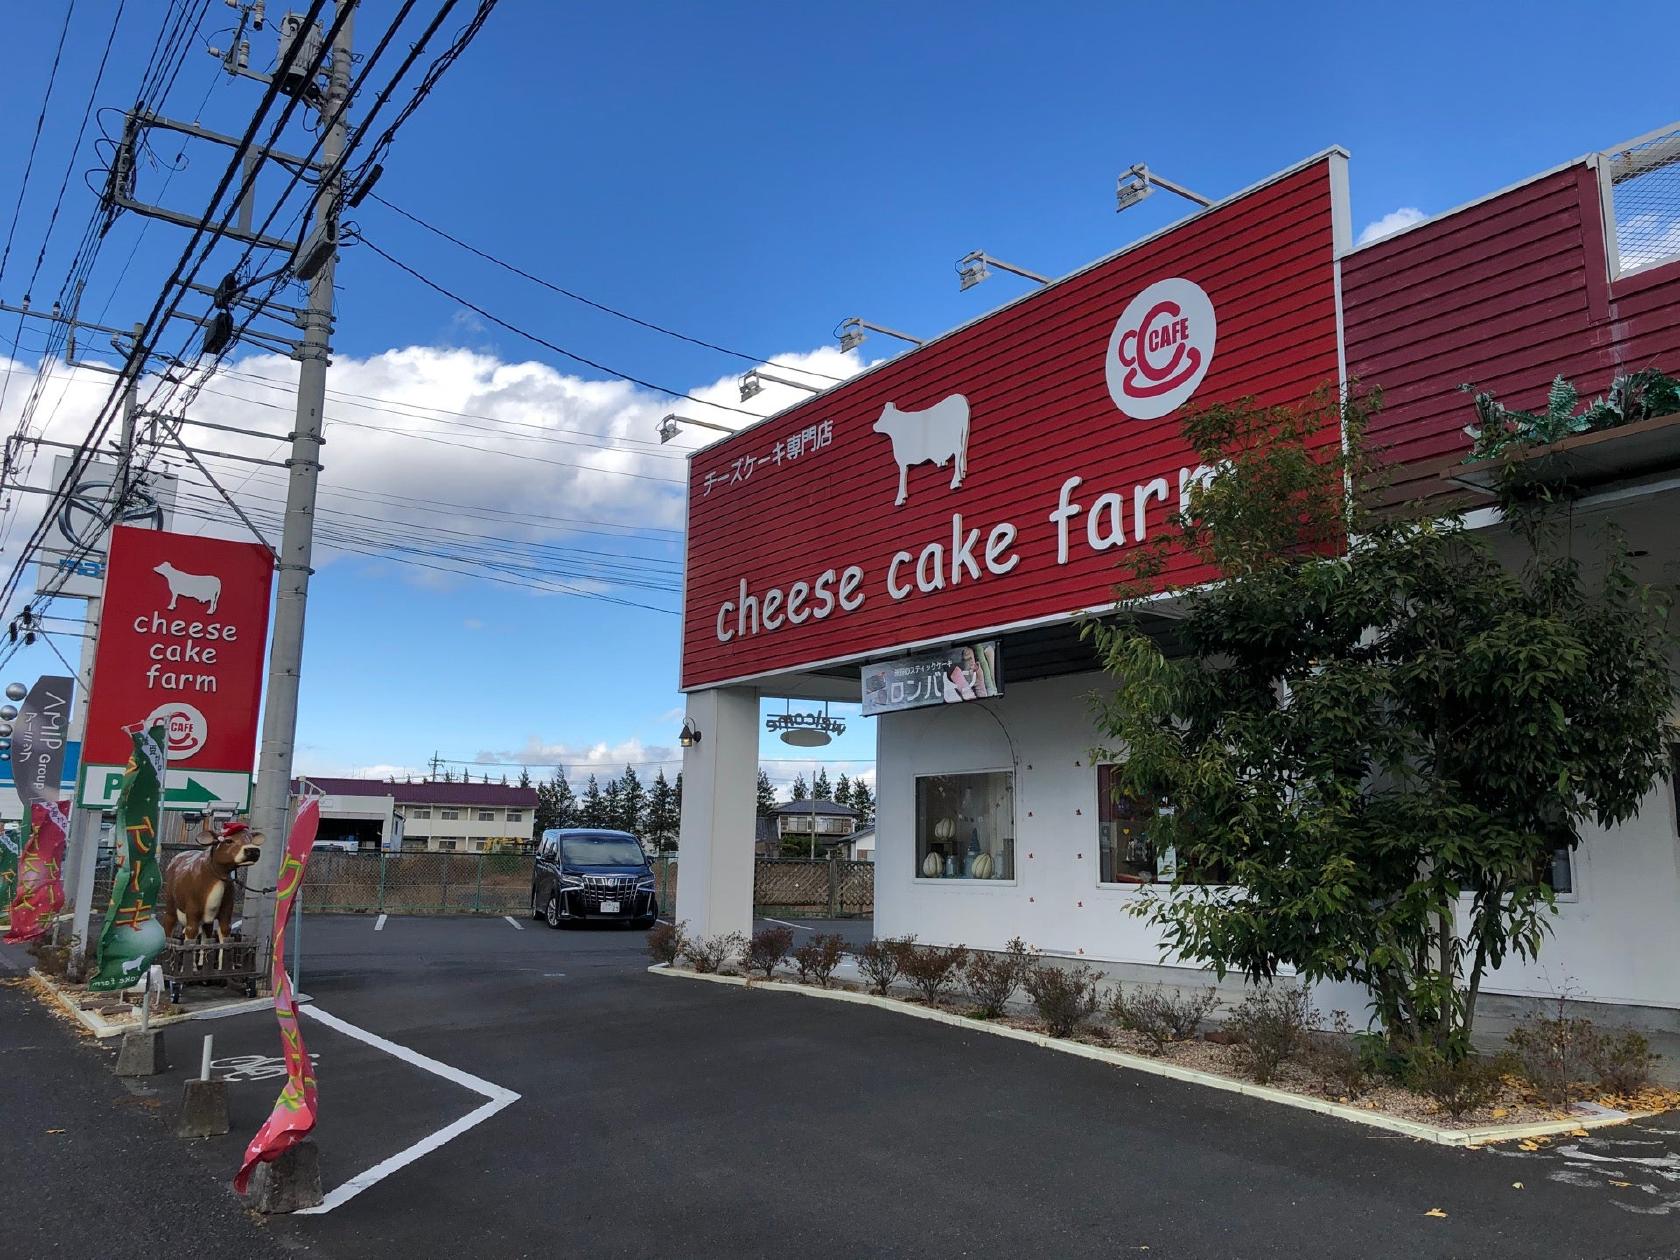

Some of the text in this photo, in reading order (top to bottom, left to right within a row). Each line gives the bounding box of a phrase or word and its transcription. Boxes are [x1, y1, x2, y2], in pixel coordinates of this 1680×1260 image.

[1148, 317, 1189, 353] CAFE
[703, 419, 834, 497] チーズケーキ専門店
[716, 564, 865, 643] cheese
[887, 513, 1020, 600] cake
[134, 611, 238, 642] cheese
[149, 639, 217, 664] cake
[146, 664, 217, 691] farm
[170, 722, 194, 733] CAFE
[33, 753, 53, 790] Group
